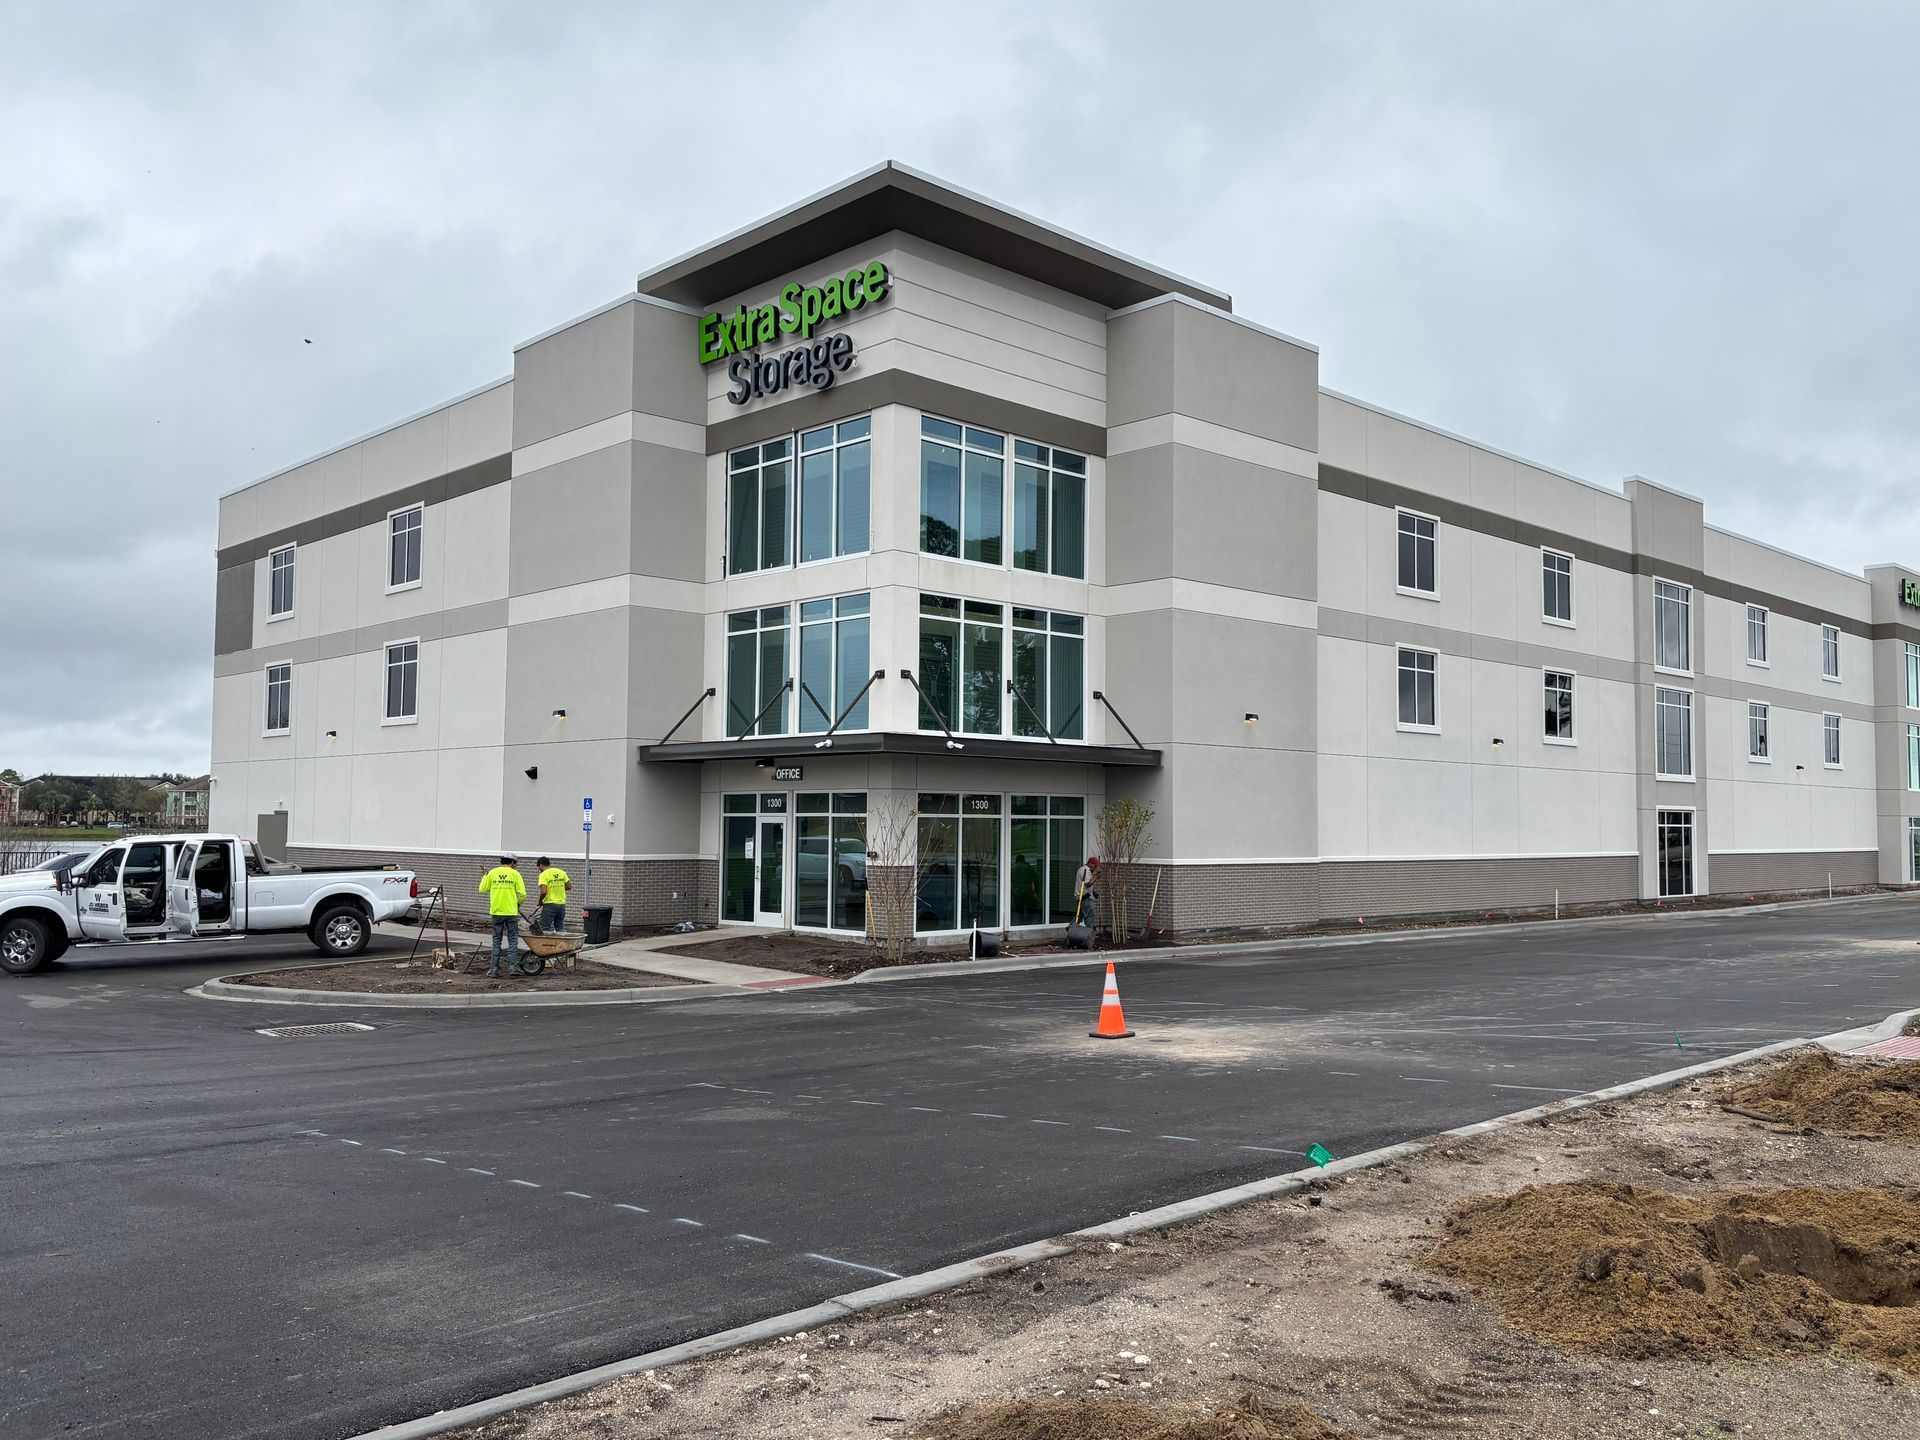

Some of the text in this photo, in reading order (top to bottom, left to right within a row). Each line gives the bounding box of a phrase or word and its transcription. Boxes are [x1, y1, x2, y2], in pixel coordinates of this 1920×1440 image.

[700, 261, 889, 365] Extra Space
[727, 333, 853, 405] Storage
[776, 768, 801, 779] OFFICE
[767, 798, 782, 808] 1300
[970, 799, 989, 810] 1300
